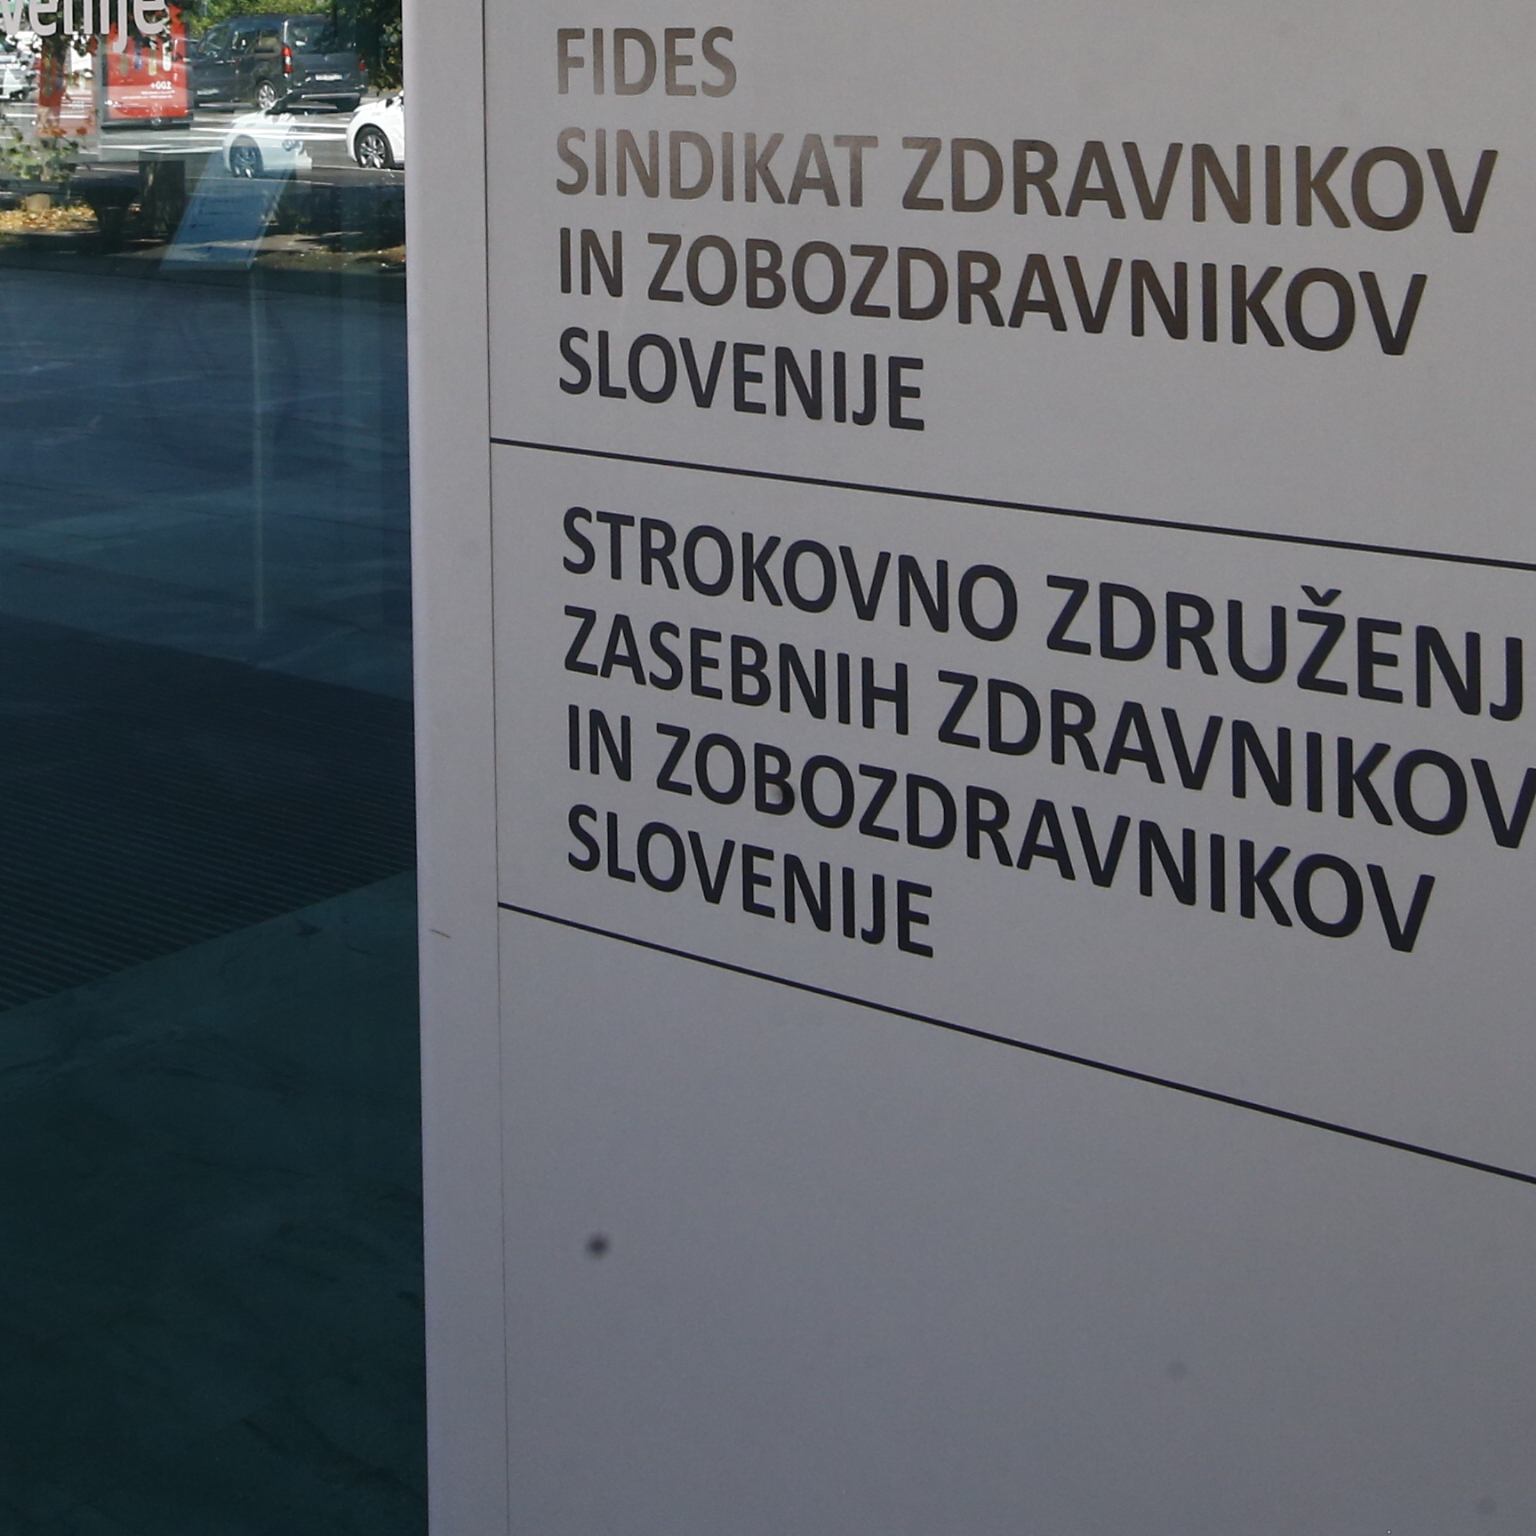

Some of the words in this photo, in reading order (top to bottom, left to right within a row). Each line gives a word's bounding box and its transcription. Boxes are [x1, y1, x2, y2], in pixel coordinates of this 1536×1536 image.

[557, 26, 737, 98] FIDES
[556, 126, 878, 209] SINDIKAT
[901, 136, 1498, 235] ZDRAVNIKOV
[559, 227, 624, 298] IN
[647, 233, 1427, 356] ZOBOZDRAVNIKOV
[558, 327, 925, 431] SLOVENIJE
[562, 506, 1018, 642] STROKOVNO
[563, 606, 910, 736] ZASEBNIH
[568, 704, 632, 783] IN
[655, 722, 1436, 954] ZOBOZDRAVNIKOV
[568, 805, 934, 958] SLOVENIJE
